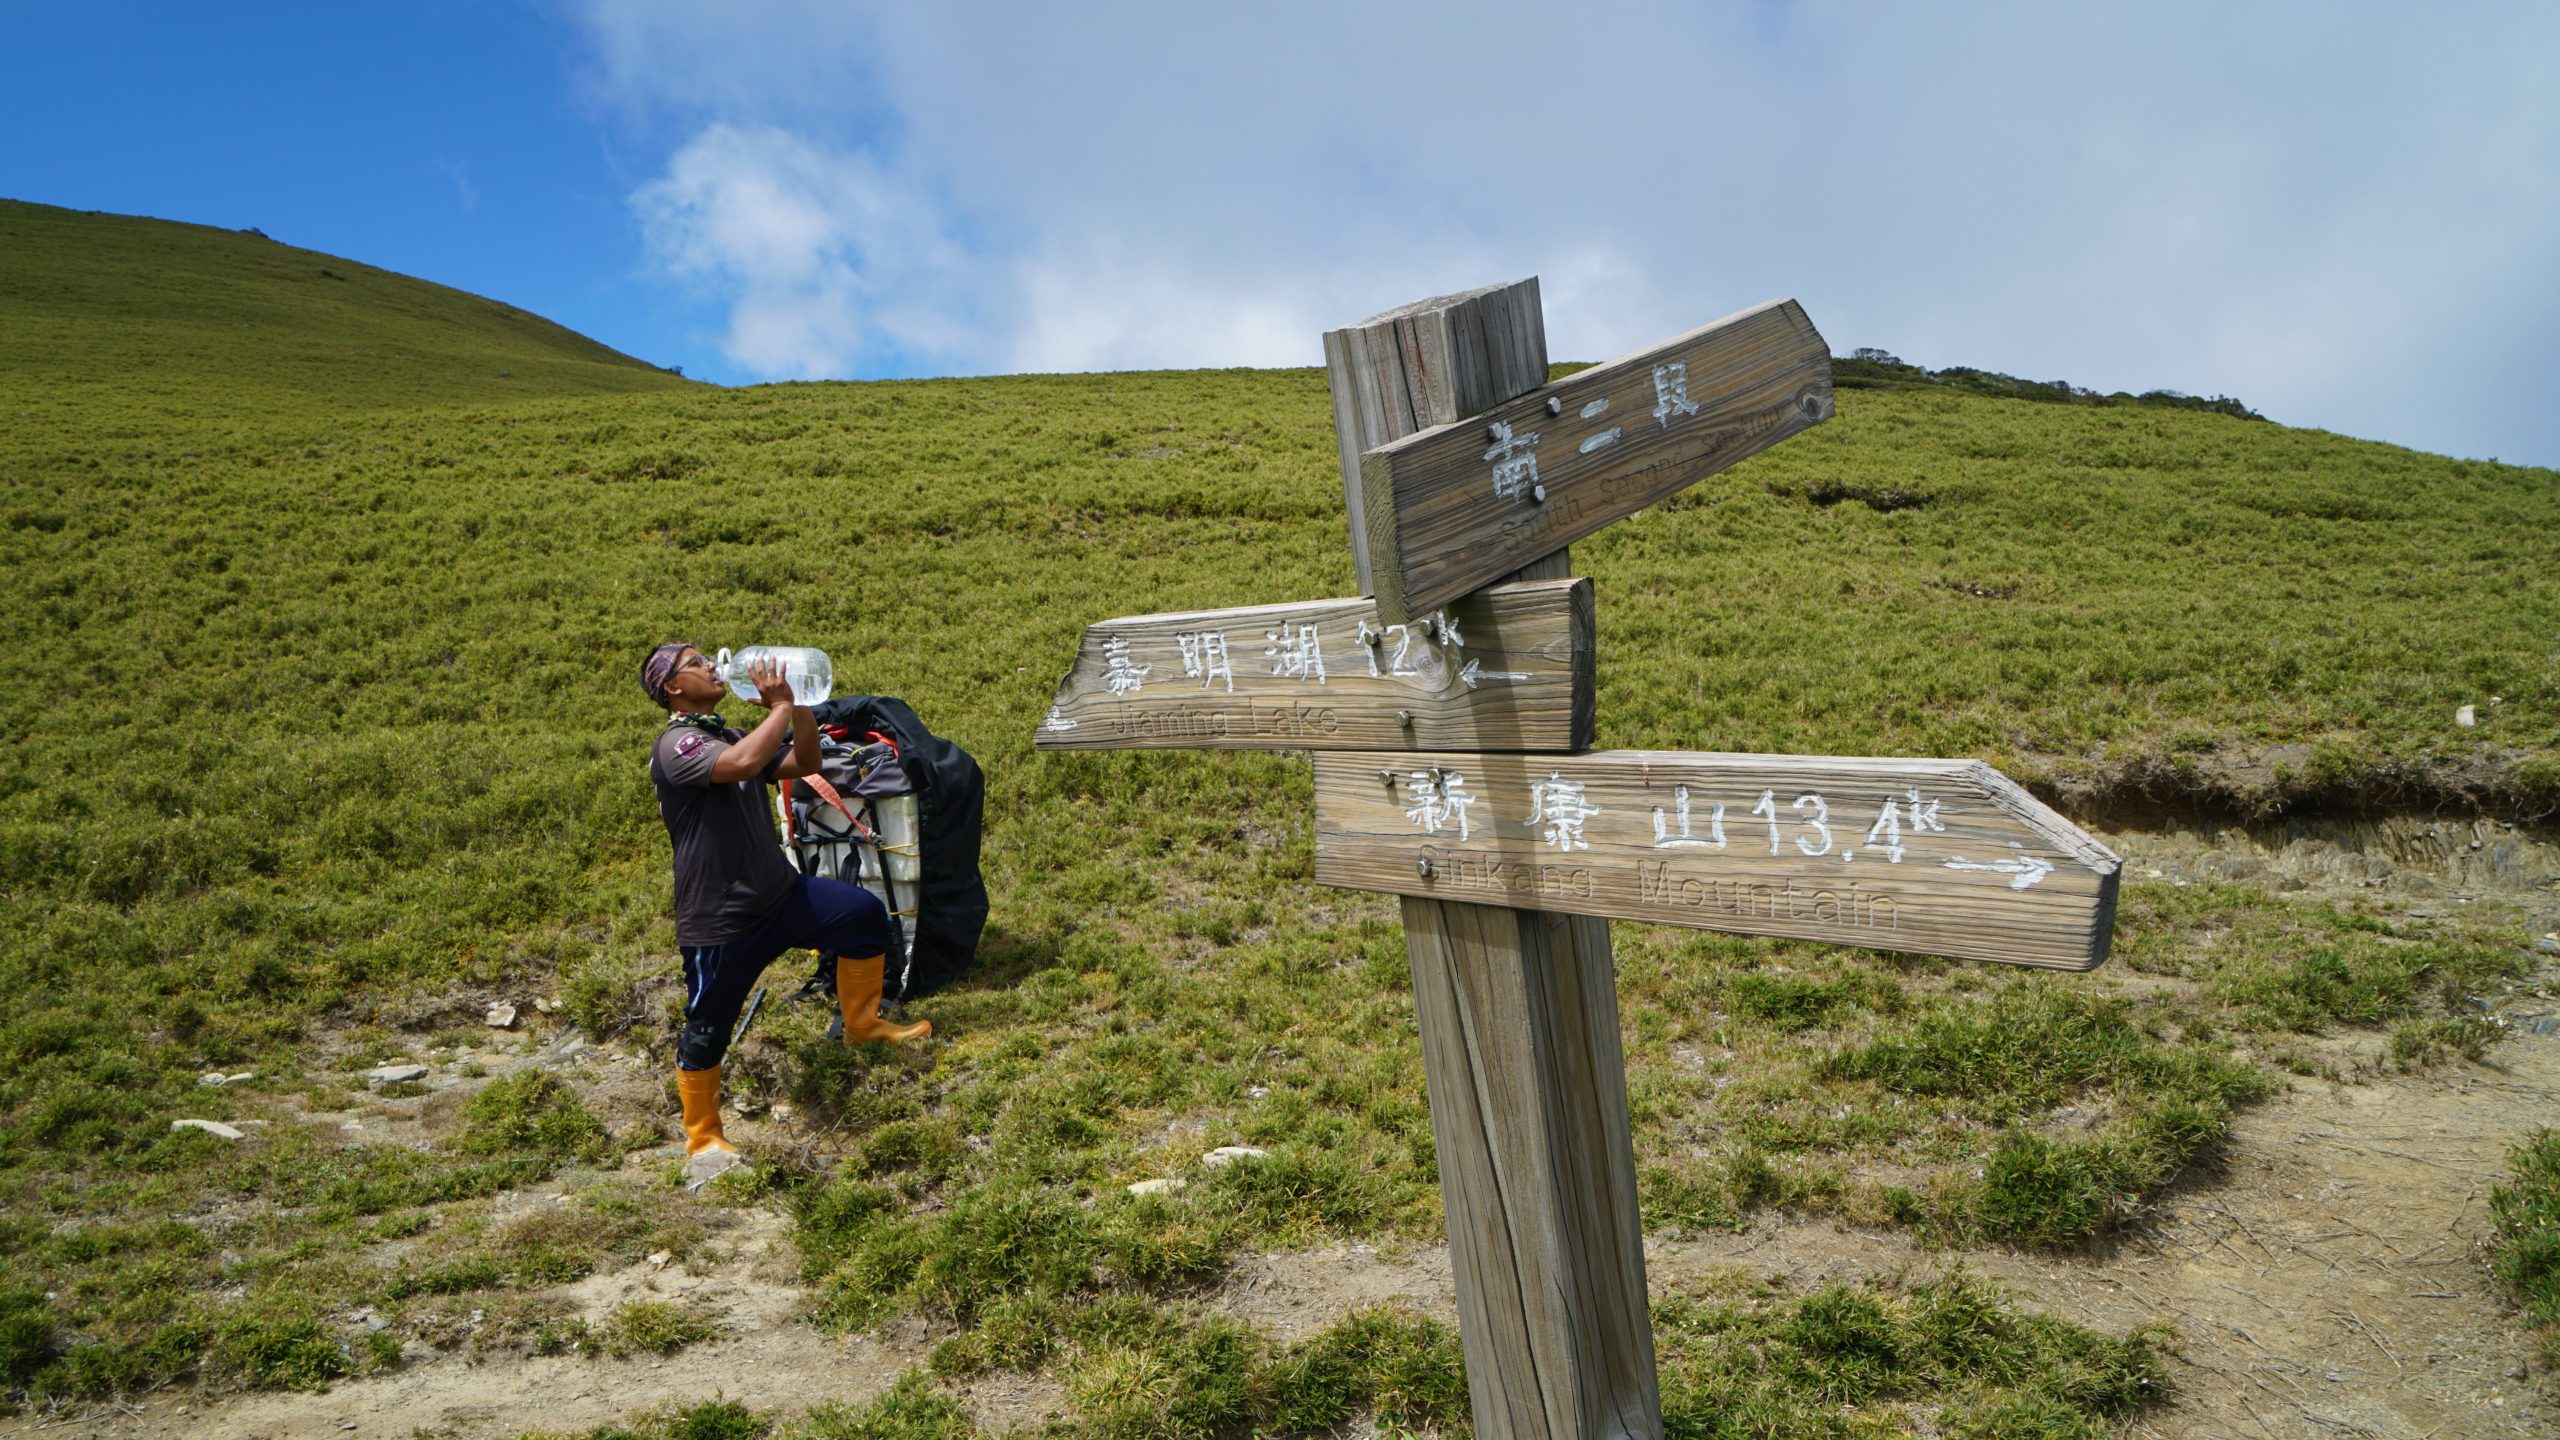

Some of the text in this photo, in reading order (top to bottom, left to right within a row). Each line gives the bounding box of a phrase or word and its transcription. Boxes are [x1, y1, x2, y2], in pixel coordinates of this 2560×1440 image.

[1482, 358, 1700, 504] 南二段
[1500, 404, 1785, 553] South Second Section
[1099, 620, 1326, 696] 嘉明湖
[1111, 696, 1339, 738] Jiaming Lake
[1406, 770, 1727, 852] 新康山
[1636, 858, 1898, 930] Mountain
